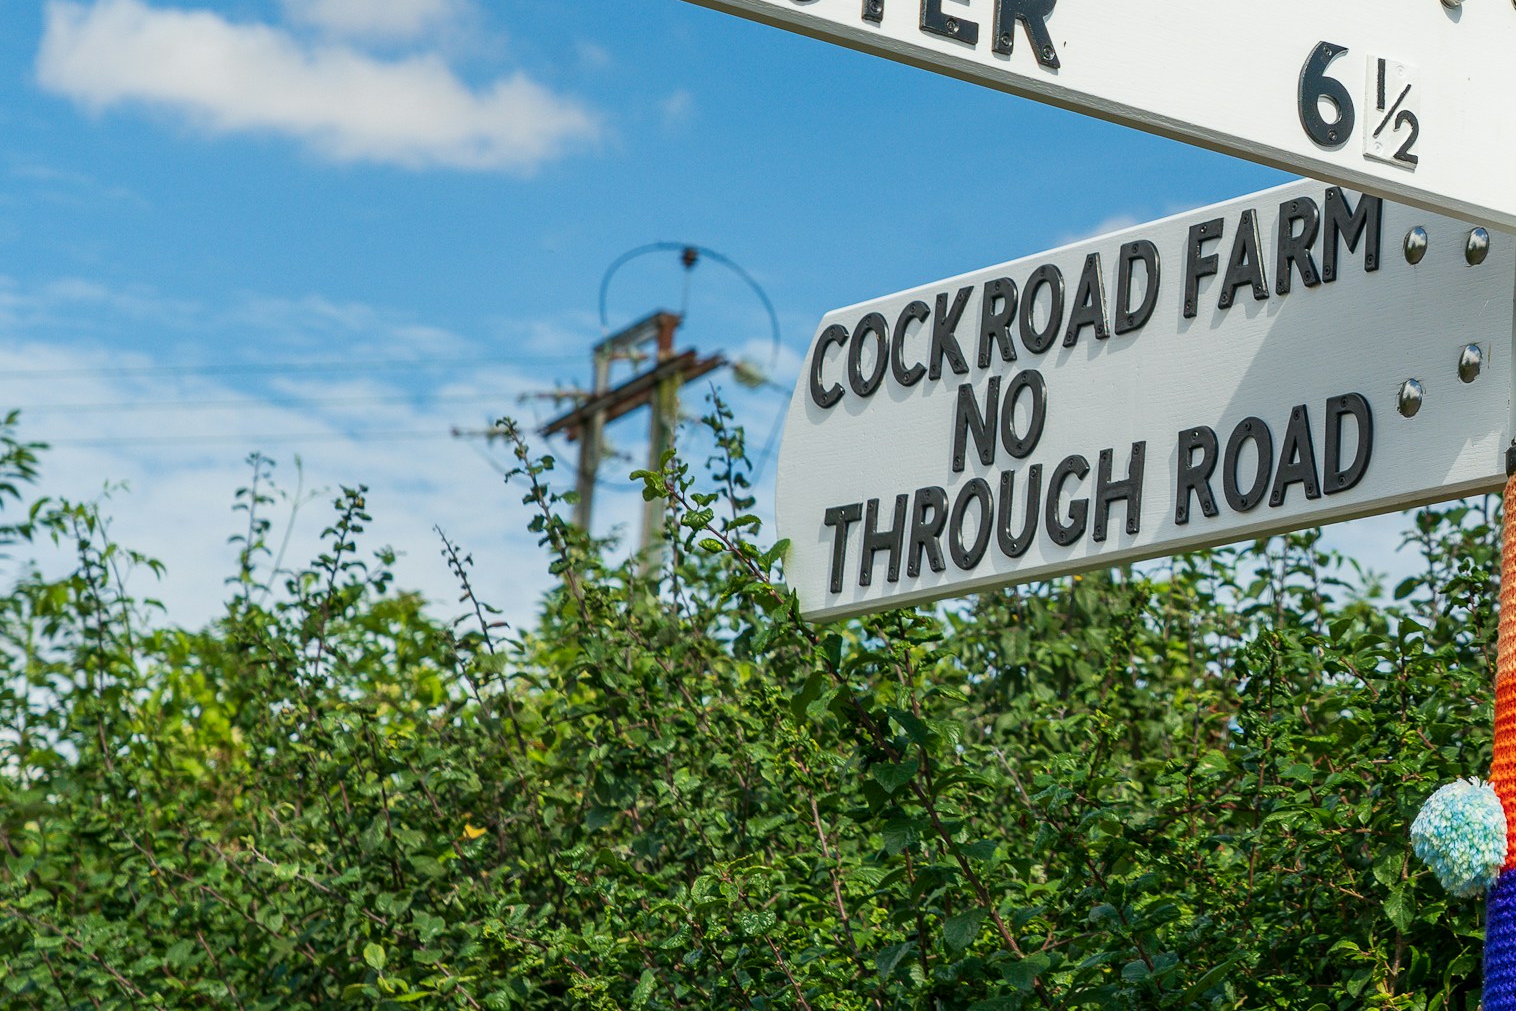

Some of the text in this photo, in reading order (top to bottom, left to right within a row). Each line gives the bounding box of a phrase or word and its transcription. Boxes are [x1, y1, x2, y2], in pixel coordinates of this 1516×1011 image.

[809, 187, 1383, 410] COCKROAD FARM
[823, 392, 1374, 596] THROUGH ROAD
[952, 370, 1048, 474] NO
